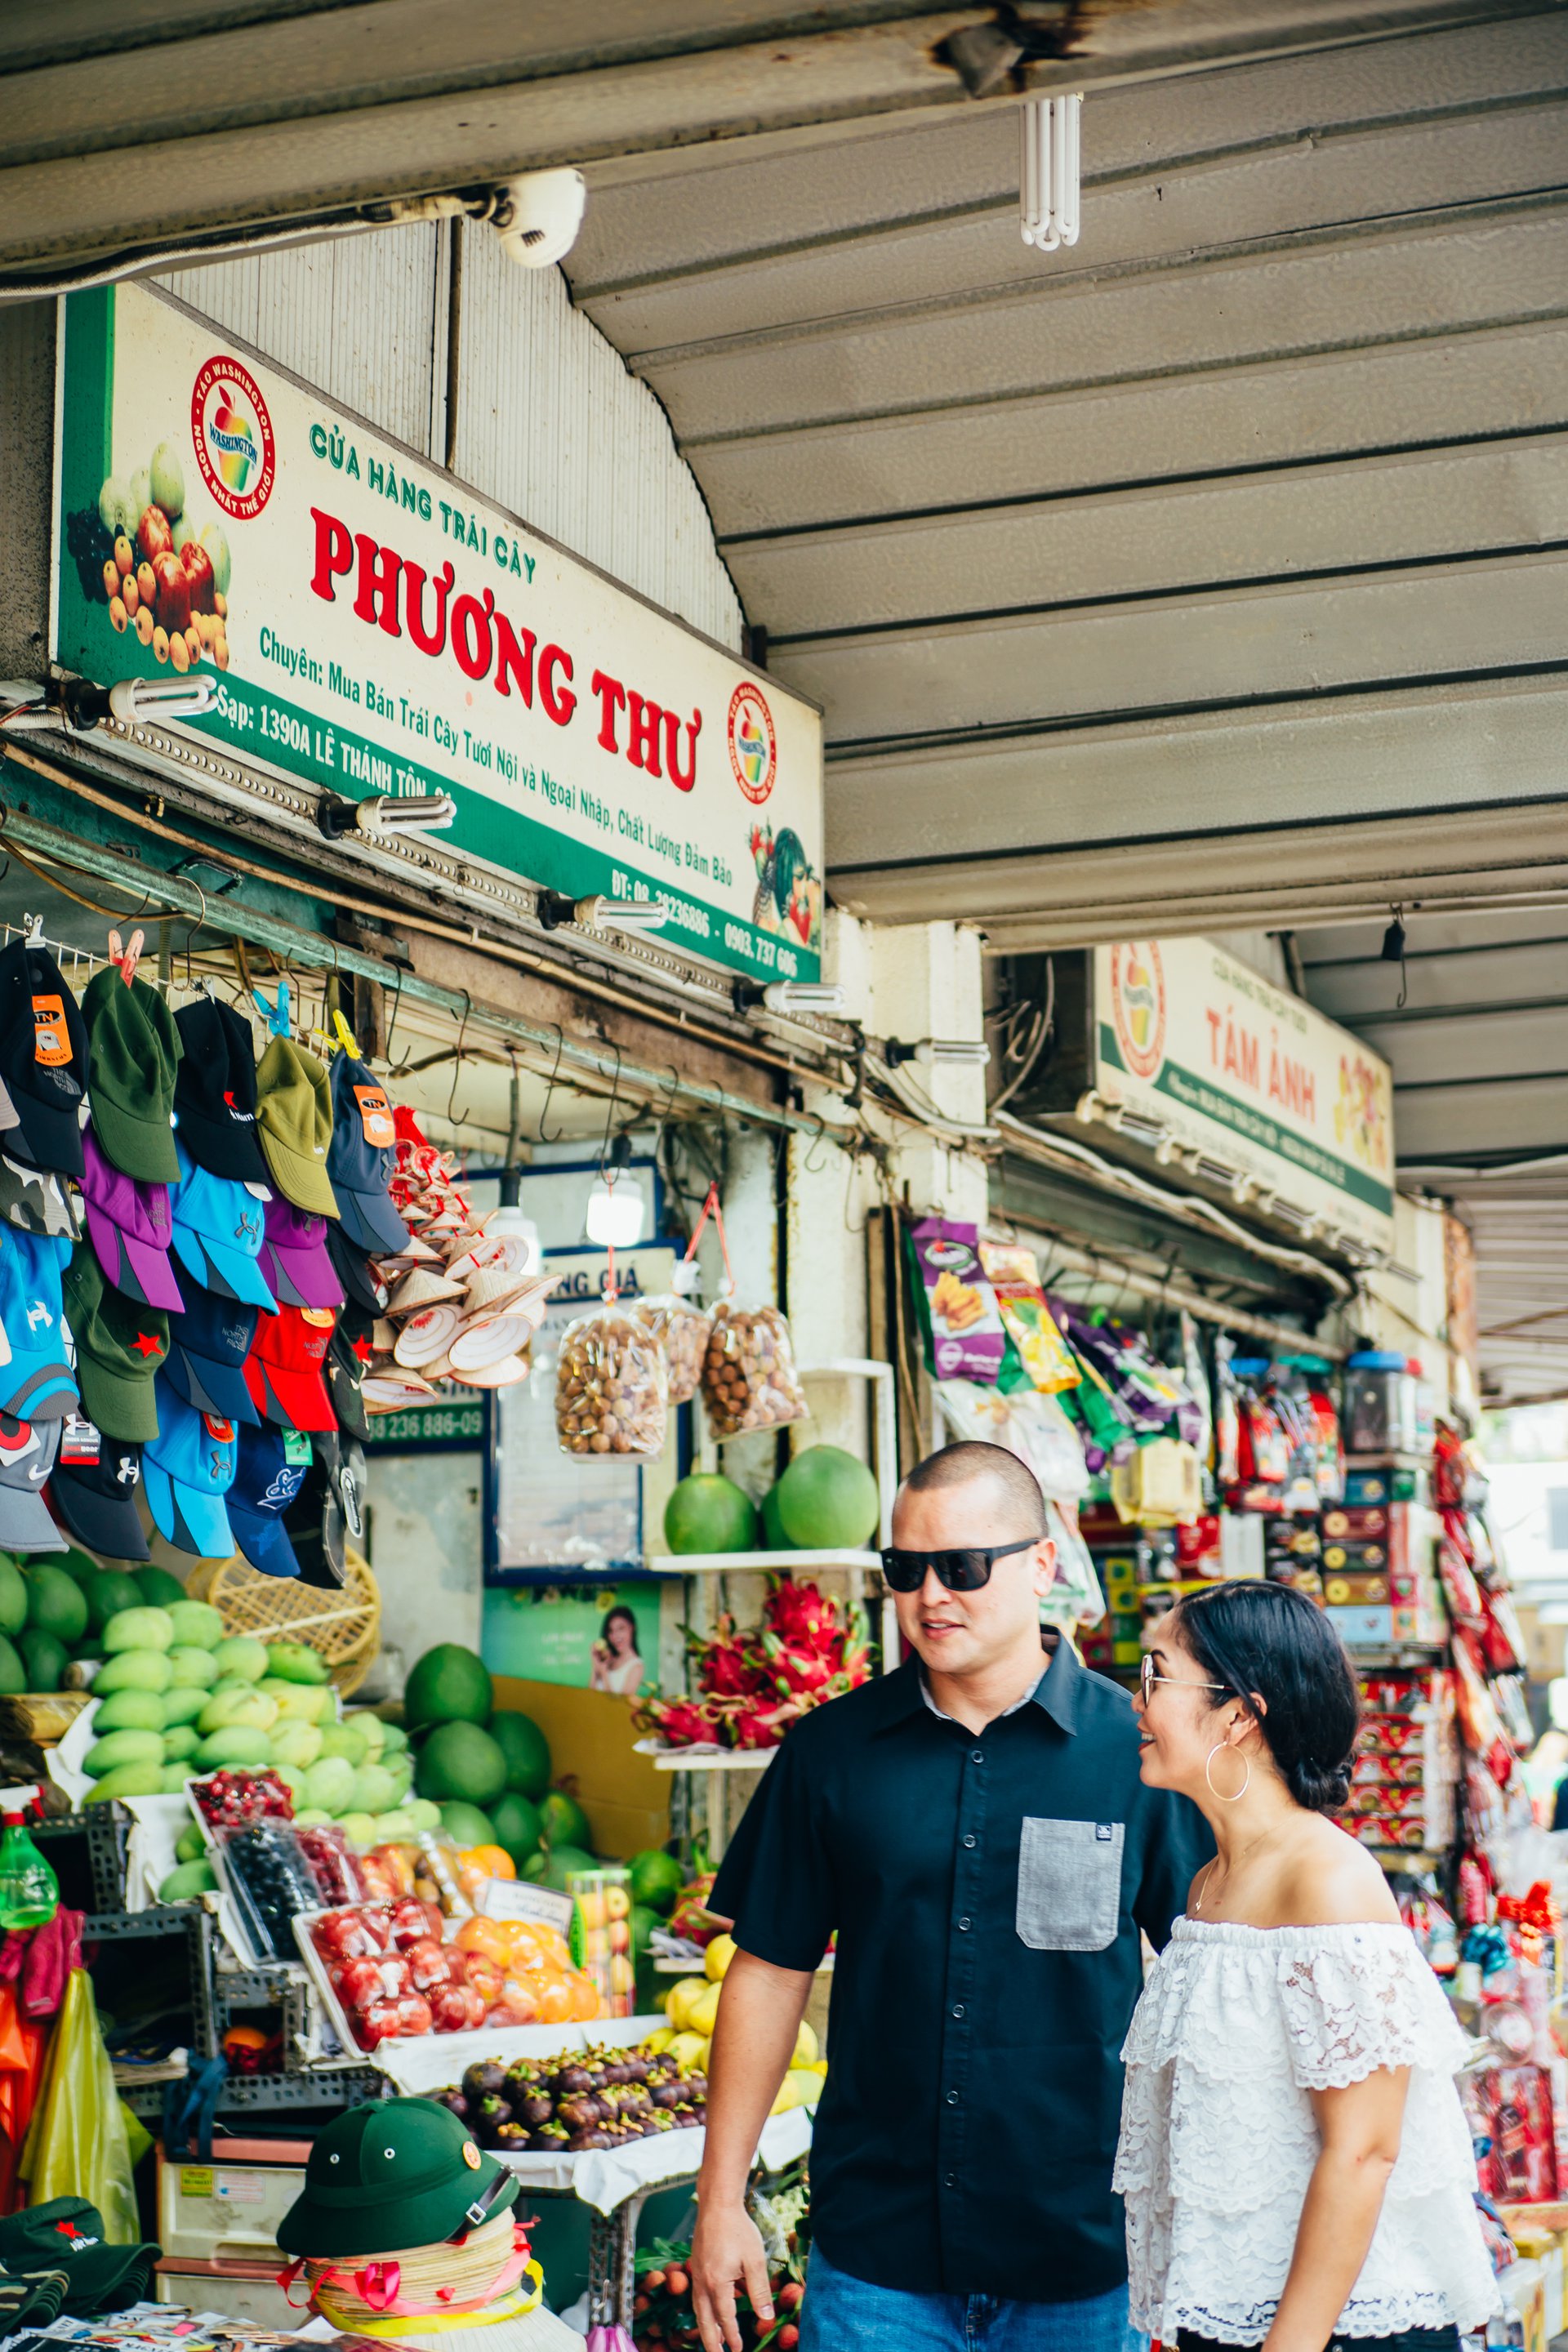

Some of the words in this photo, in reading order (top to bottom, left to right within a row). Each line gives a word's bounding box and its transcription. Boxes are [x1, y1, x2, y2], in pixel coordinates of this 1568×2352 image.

[194, 425, 212, 479] NGON
[209, 421, 258, 464] WASHINGTON
[212, 363, 271, 441] WASHINGTON
[310, 424, 360, 480] CỬA
[368, 457, 432, 521] HÀNG
[439, 500, 488, 556] TRÁI
[493, 535, 536, 584] CÂY
[310, 506, 577, 727] PHƯƠNG
[591, 668, 702, 793] THƯ
[216, 684, 254, 731] Sạp:
[260, 705, 310, 757] 1390A
[316, 727, 335, 768] LÊ
[341, 741, 392, 794] THÁNH
[396, 765, 426, 798] TÔN
[260, 626, 323, 686] Chuyên:
[328, 661, 360, 704] Mua
[366, 679, 394, 721] Bán
[399, 697, 429, 737] Trái
[433, 715, 459, 756] Cây
[497, 746, 518, 785] Nội
[522, 764, 536, 791] và
[541, 769, 577, 813] Ngoại
[581, 789, 613, 834] Nhập,
[618, 808, 644, 846] Chất
[712, 856, 733, 888] Bảo
